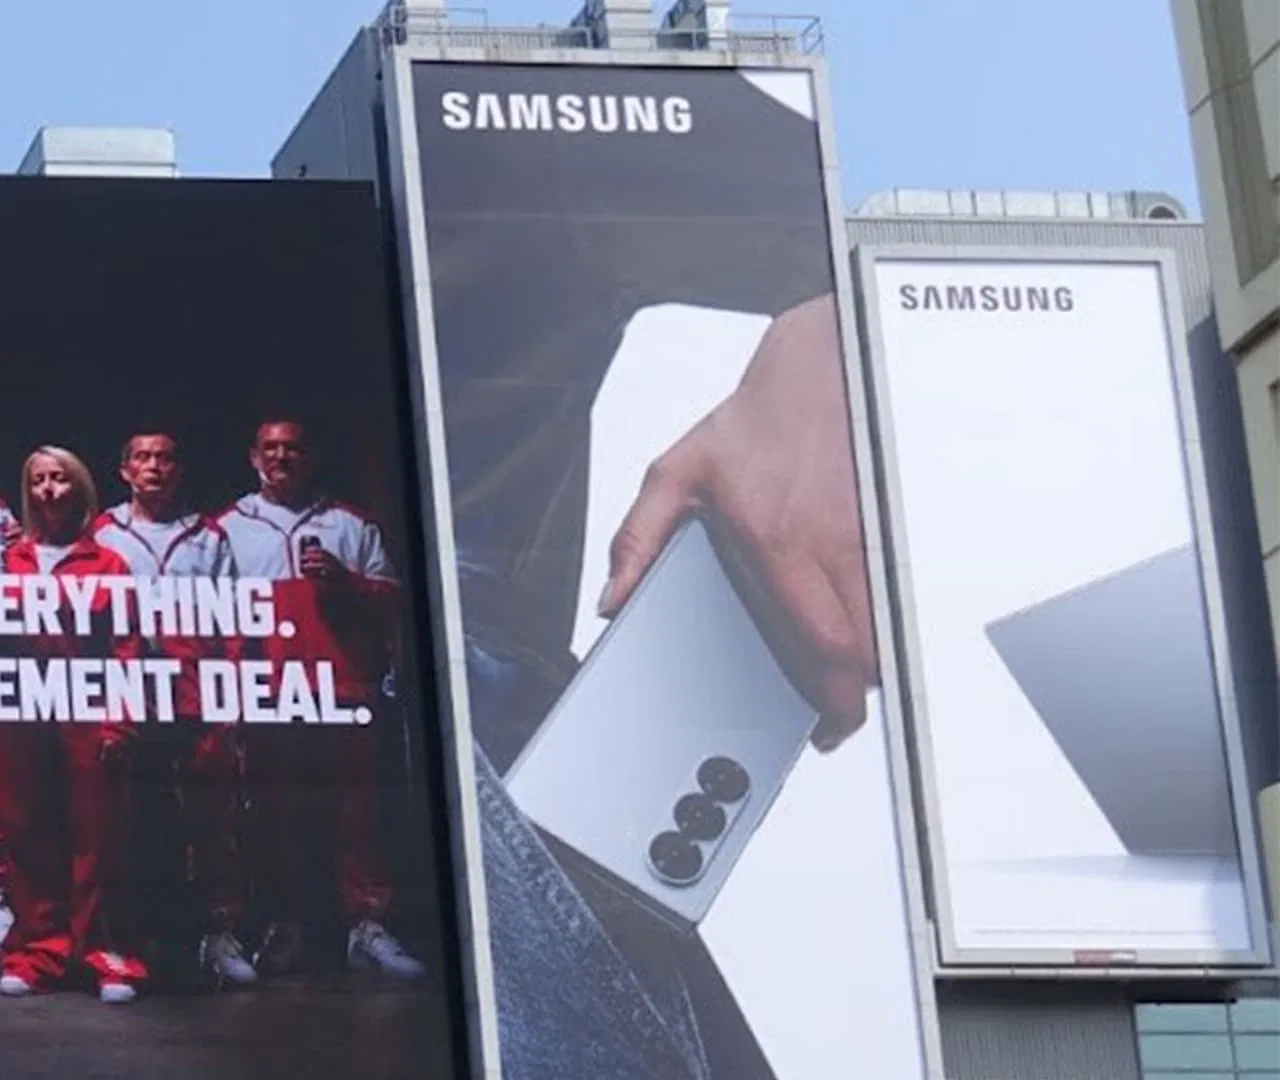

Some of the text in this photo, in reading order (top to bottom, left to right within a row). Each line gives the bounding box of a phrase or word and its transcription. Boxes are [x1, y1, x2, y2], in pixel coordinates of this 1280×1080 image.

[441, 91, 693, 134] SAMSUNG
[899, 284, 1074, 312] SAMSUNG
[198, 660, 374, 725] DEAL.
